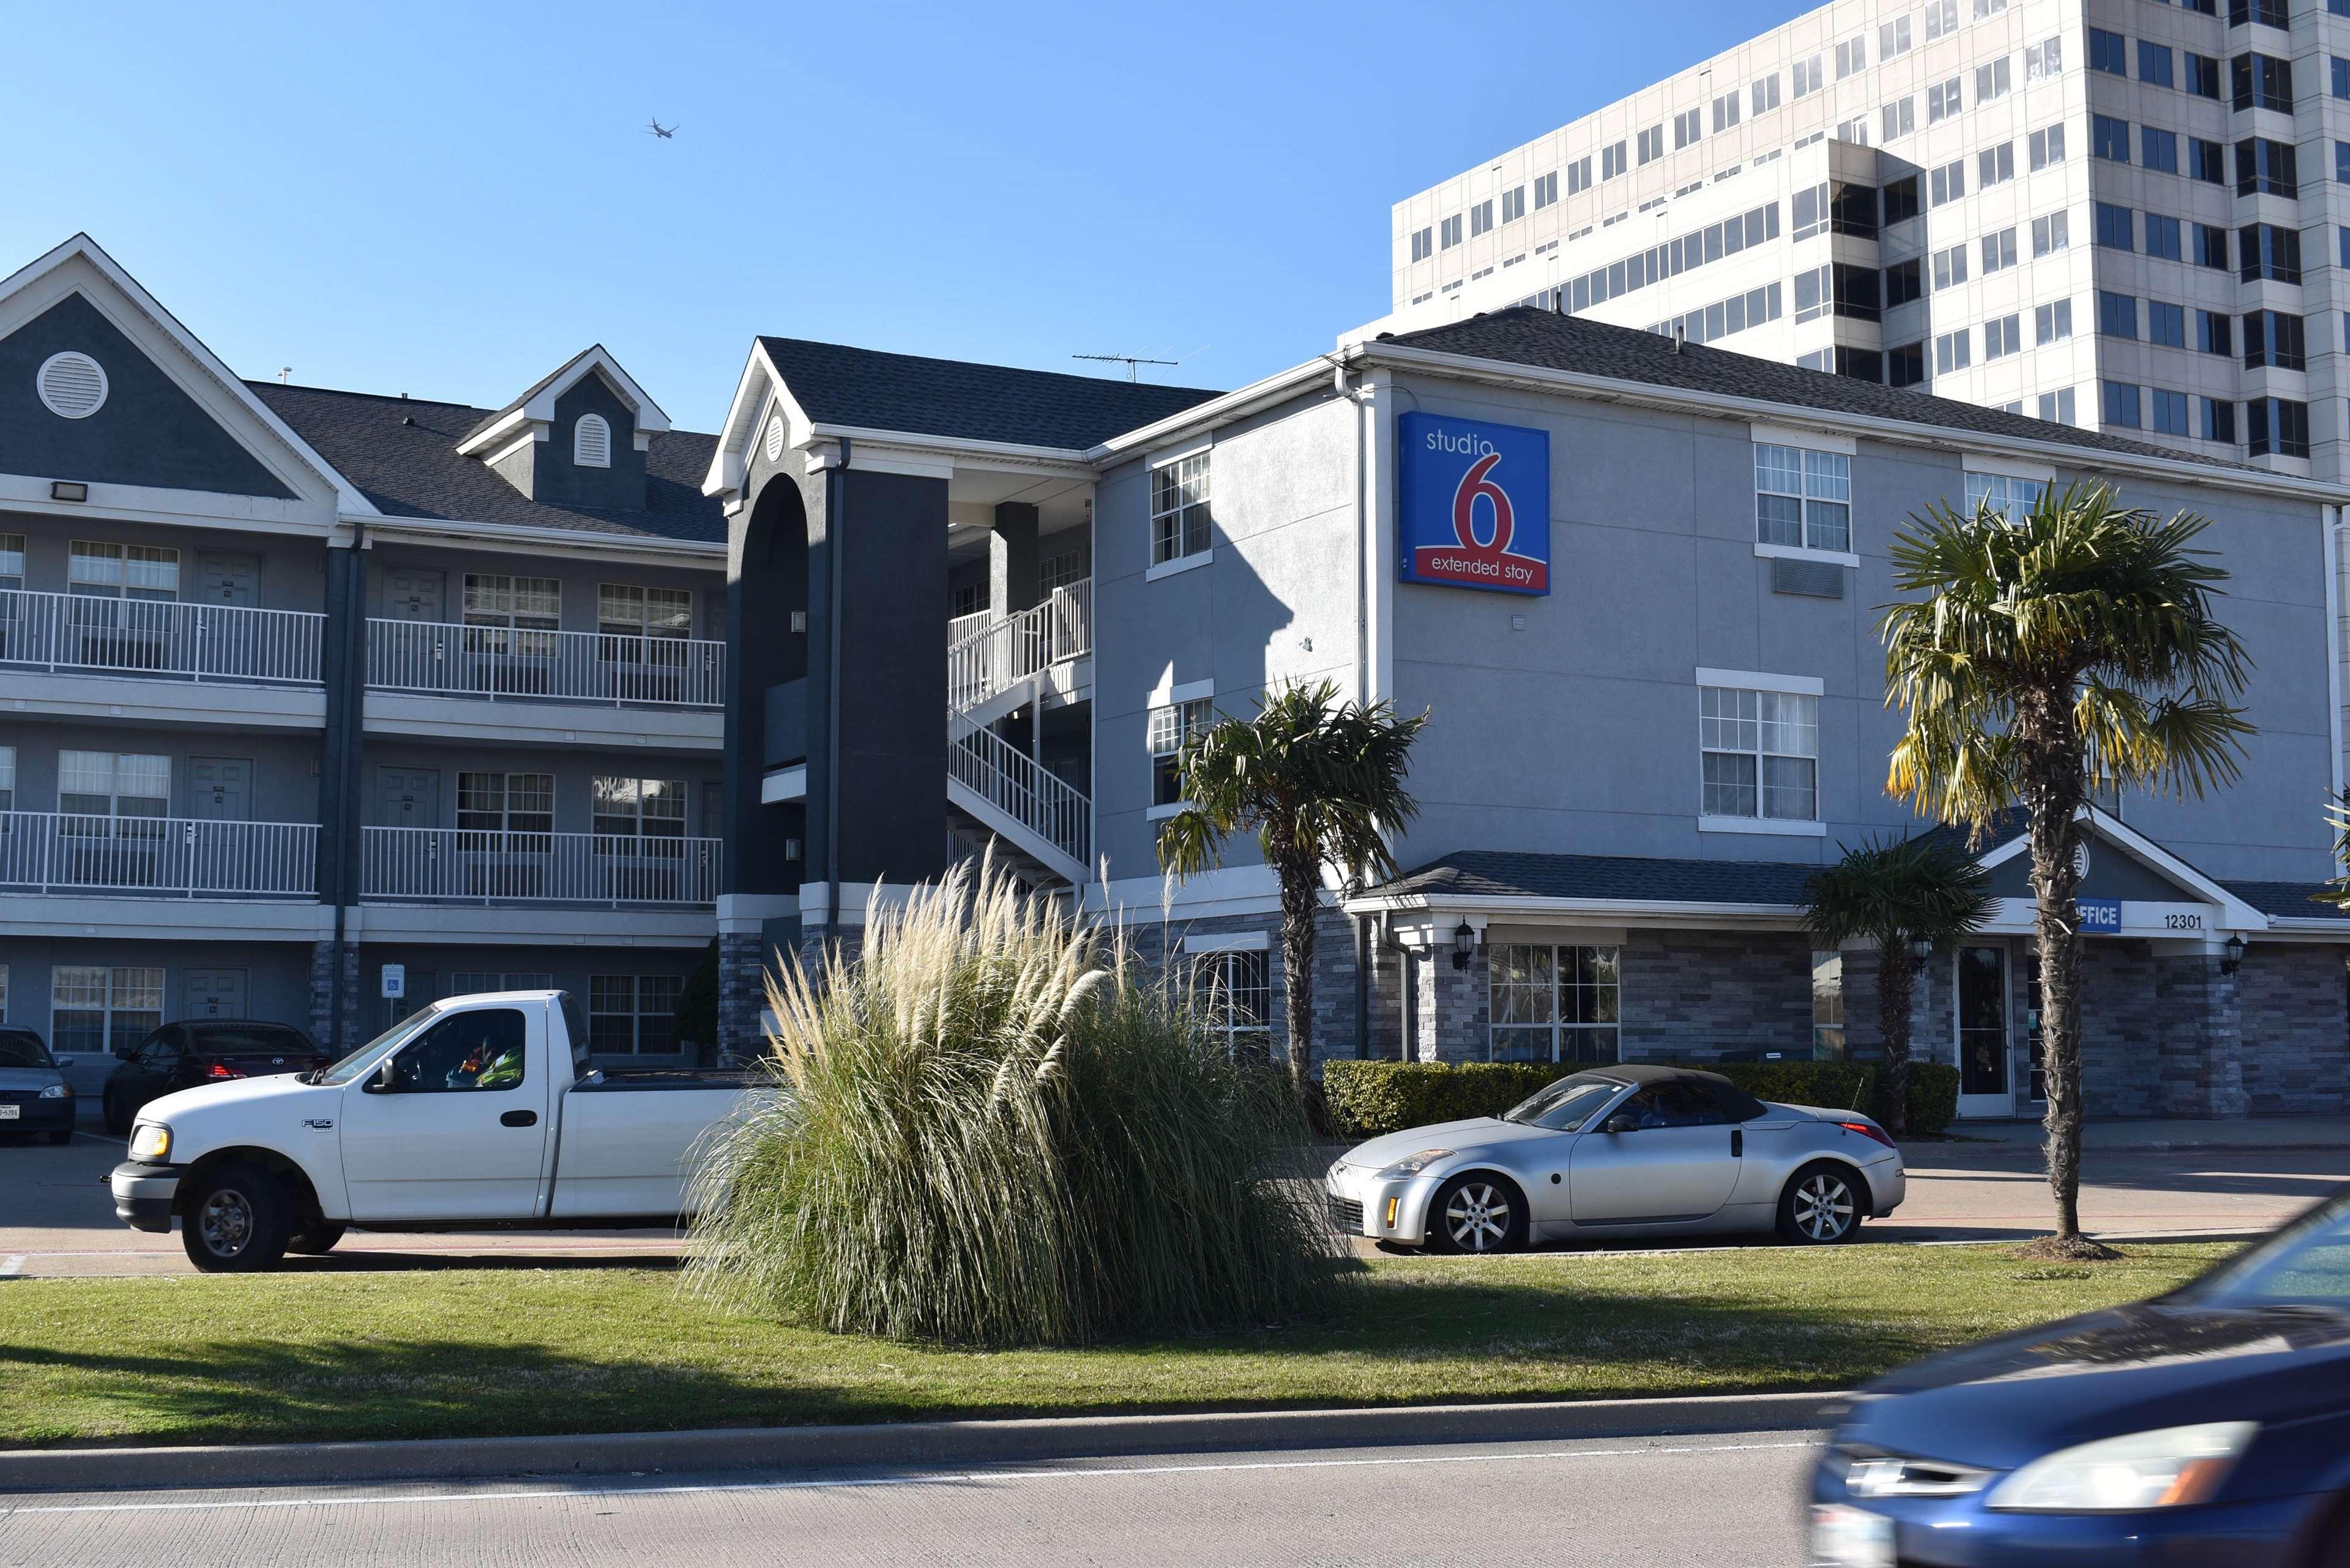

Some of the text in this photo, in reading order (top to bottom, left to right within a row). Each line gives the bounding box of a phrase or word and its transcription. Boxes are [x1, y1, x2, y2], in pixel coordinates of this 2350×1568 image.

[1427, 430, 1494, 456] studio
[1452, 452, 1515, 553] 6
[1432, 556, 1534, 584] extended stay
[2165, 914, 2201, 928] 12301
